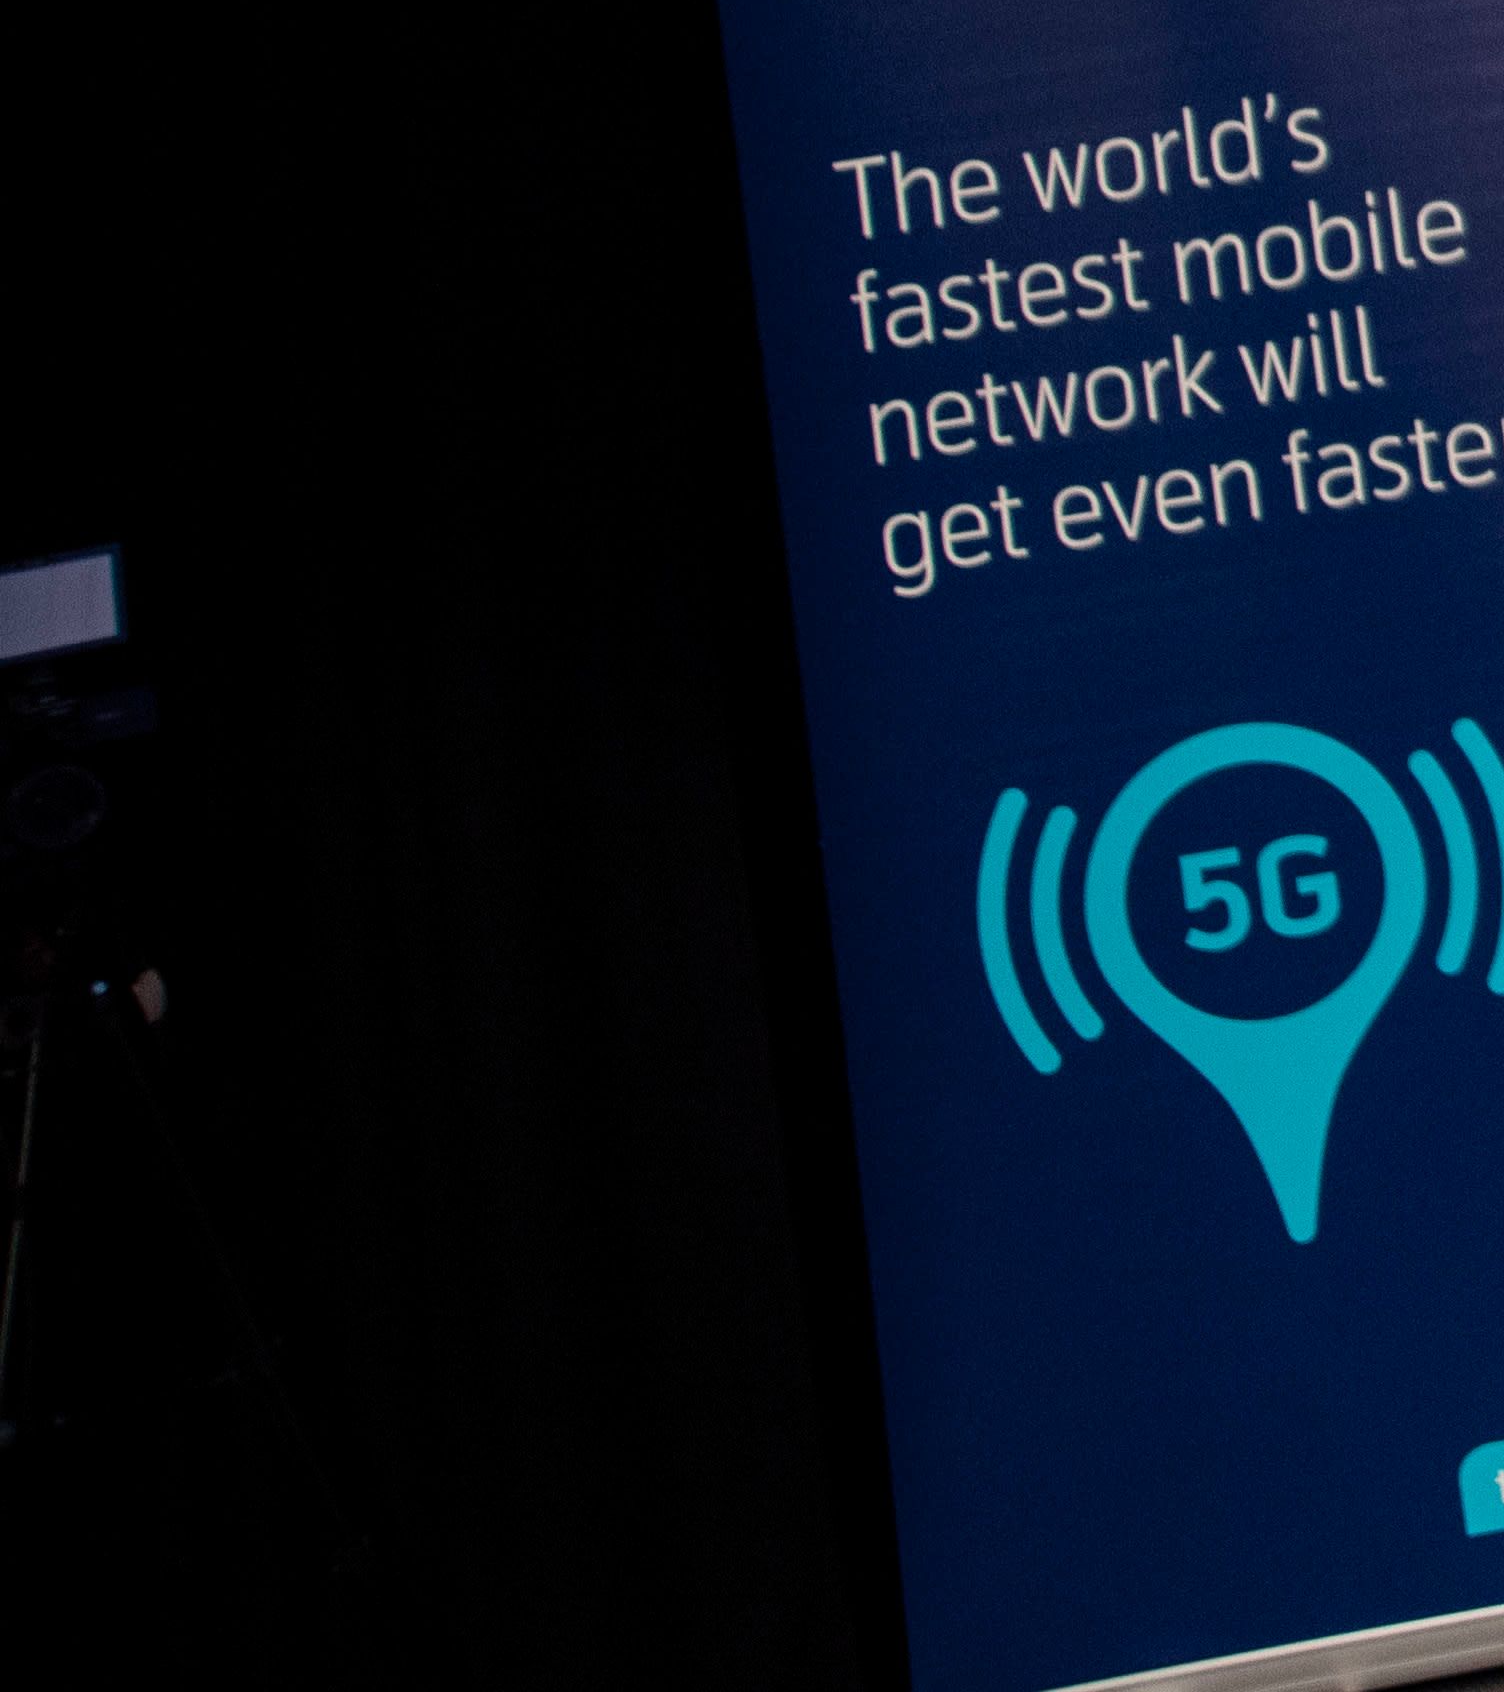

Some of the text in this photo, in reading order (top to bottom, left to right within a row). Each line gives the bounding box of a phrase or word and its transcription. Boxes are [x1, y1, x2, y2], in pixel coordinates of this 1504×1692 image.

[832, 92, 1330, 240] The world's
[849, 187, 1469, 354] fastest mobile
[867, 304, 1388, 467] network will
[881, 484, 1031, 599] get
[1051, 455, 1264, 551] even
[1177, 833, 1343, 954] 5G
